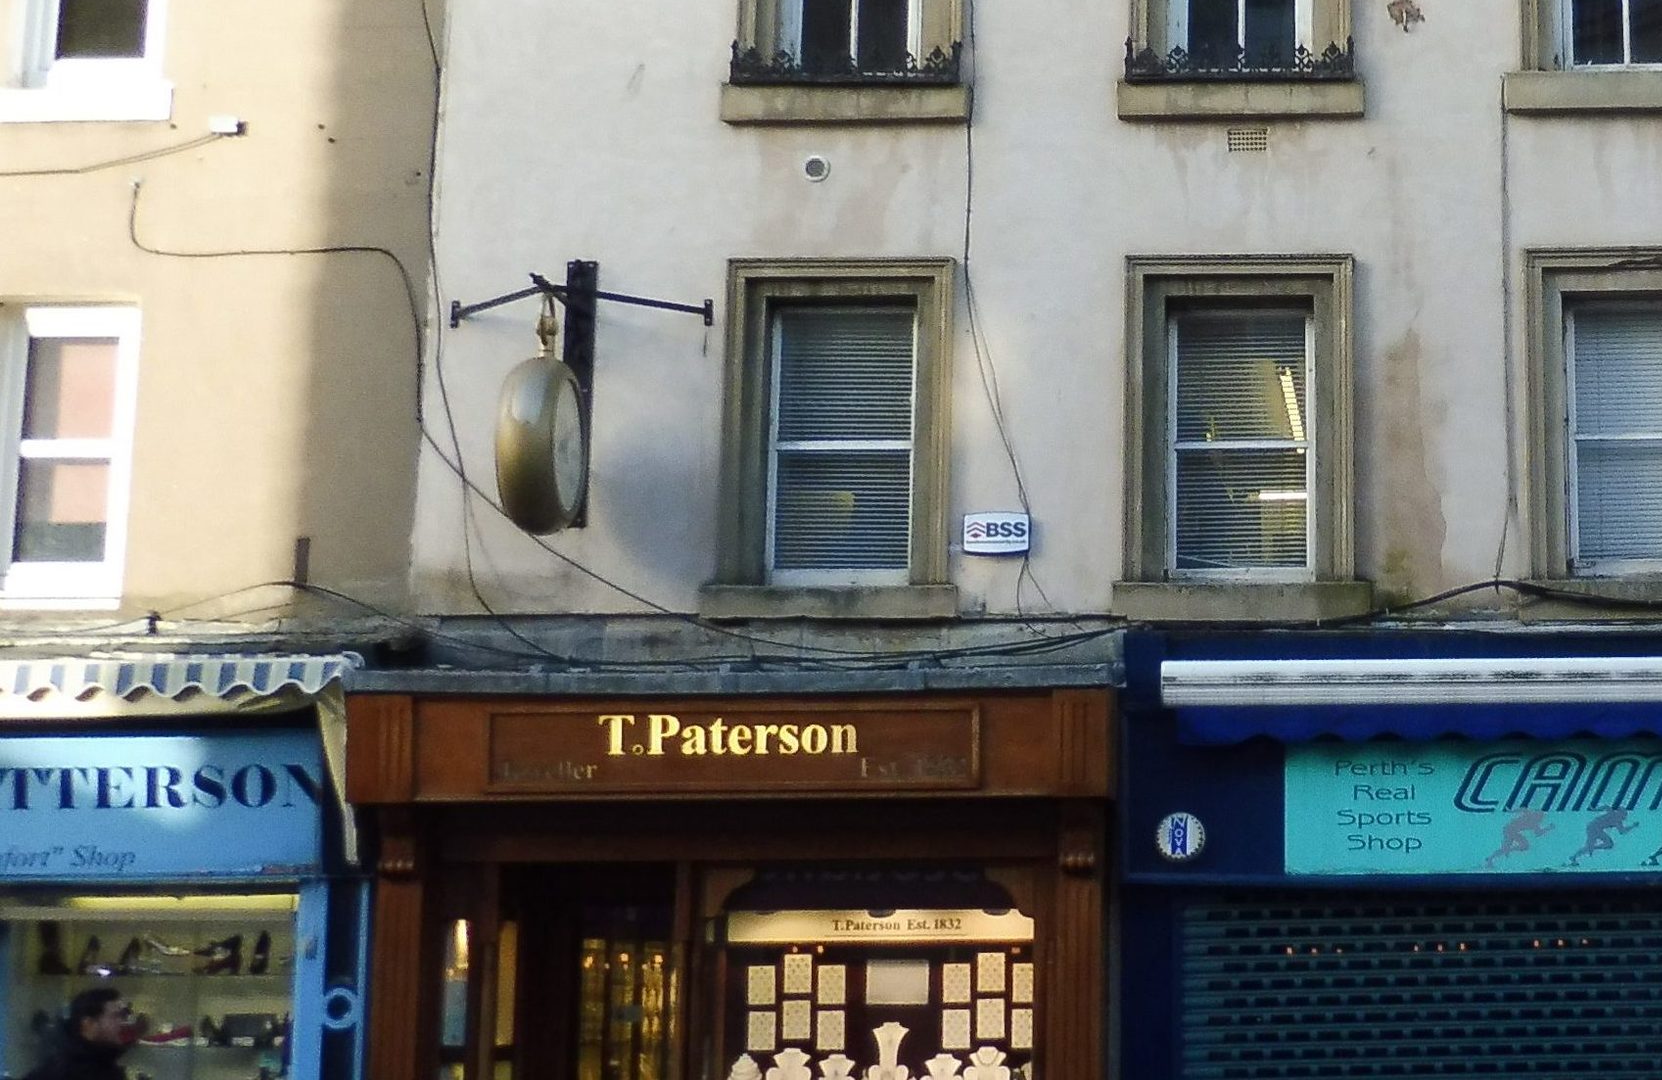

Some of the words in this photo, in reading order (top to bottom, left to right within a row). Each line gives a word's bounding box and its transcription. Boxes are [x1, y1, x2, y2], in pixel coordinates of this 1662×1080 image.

[986, 522, 1026, 537] BSS
[598, 714, 859, 756] T.Paterson
[1335, 760, 1435, 776] Perth's
[1353, 784, 1415, 800] Real
[1337, 809, 1432, 829] Sports
[1171, 814, 1187, 858] NOVA
[1347, 834, 1422, 853] Shop
[70, 845, 136, 872] Shop
[907, 919, 931, 930] Est.
[935, 918, 962, 930] 1832
